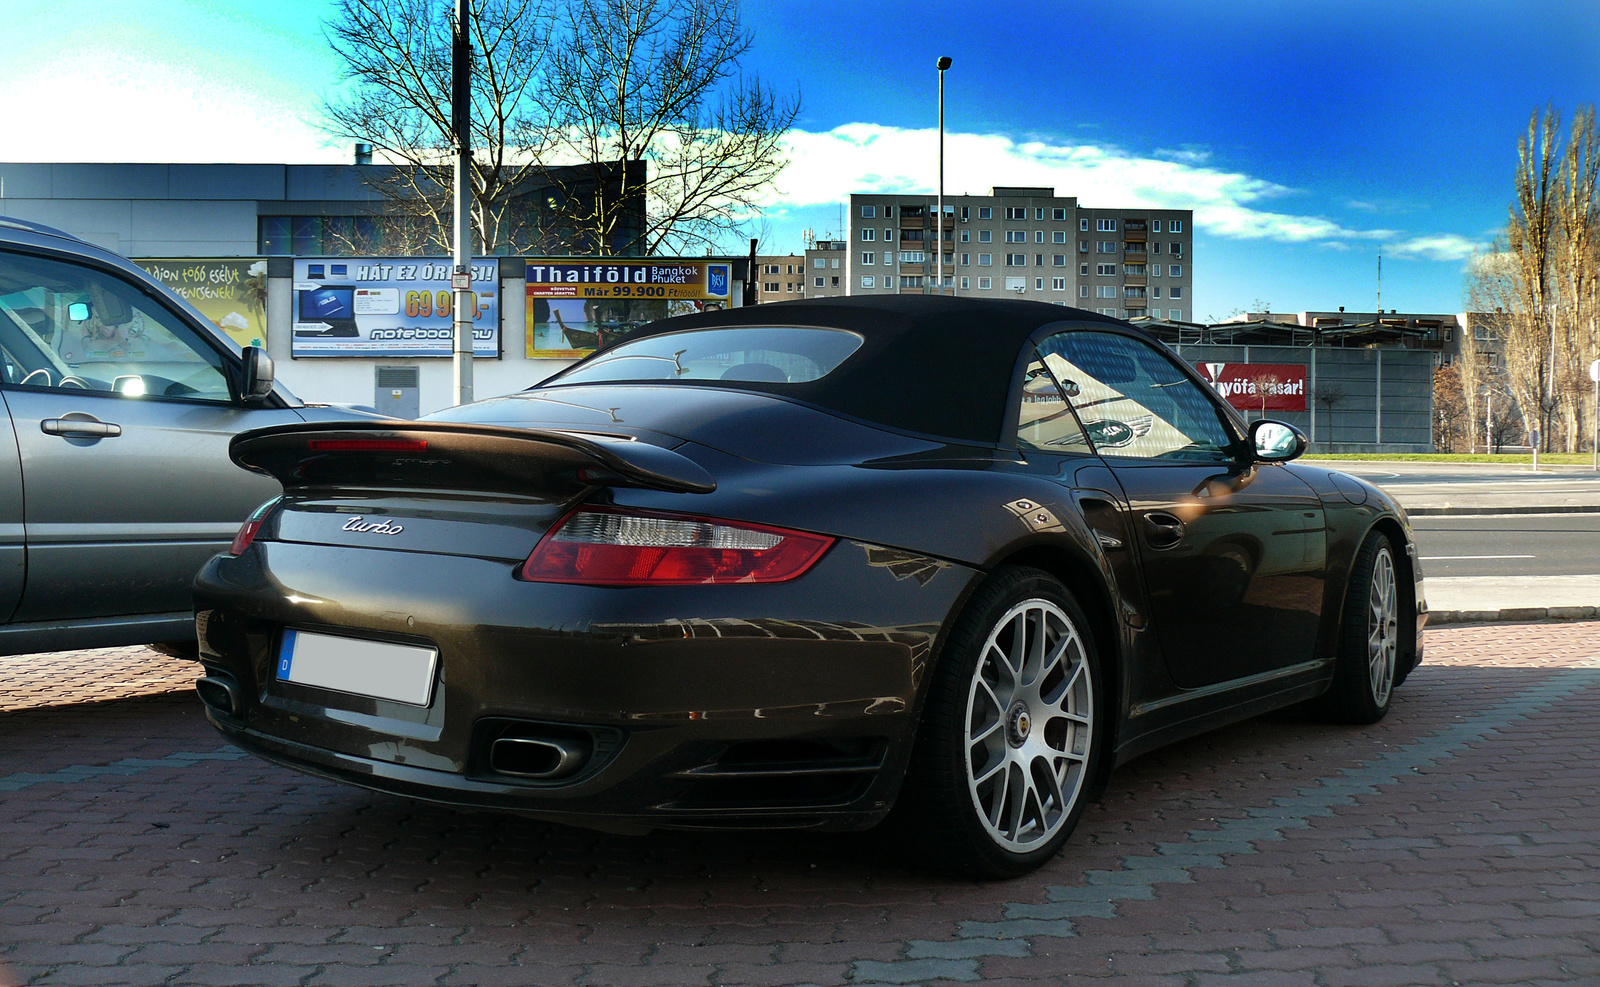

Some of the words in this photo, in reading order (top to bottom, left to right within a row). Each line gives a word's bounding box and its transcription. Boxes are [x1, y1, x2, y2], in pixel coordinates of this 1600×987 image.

[209, 265, 240, 285] esélyt
[356, 263, 393, 281] HÁT
[396, 265, 417, 281] EZ
[421, 263, 494, 281] ÓRISI!
[533, 266, 646, 283] Thaiföld
[652, 266, 698, 275] Bangkok
[652, 275, 686, 284] Phuket
[584, 287, 610, 297] Már
[612, 286, 665, 297] 99.900
[405, 290, 432, 318] 69
[342, 516, 404, 535] turbo
[281, 659, 289, 671] D
